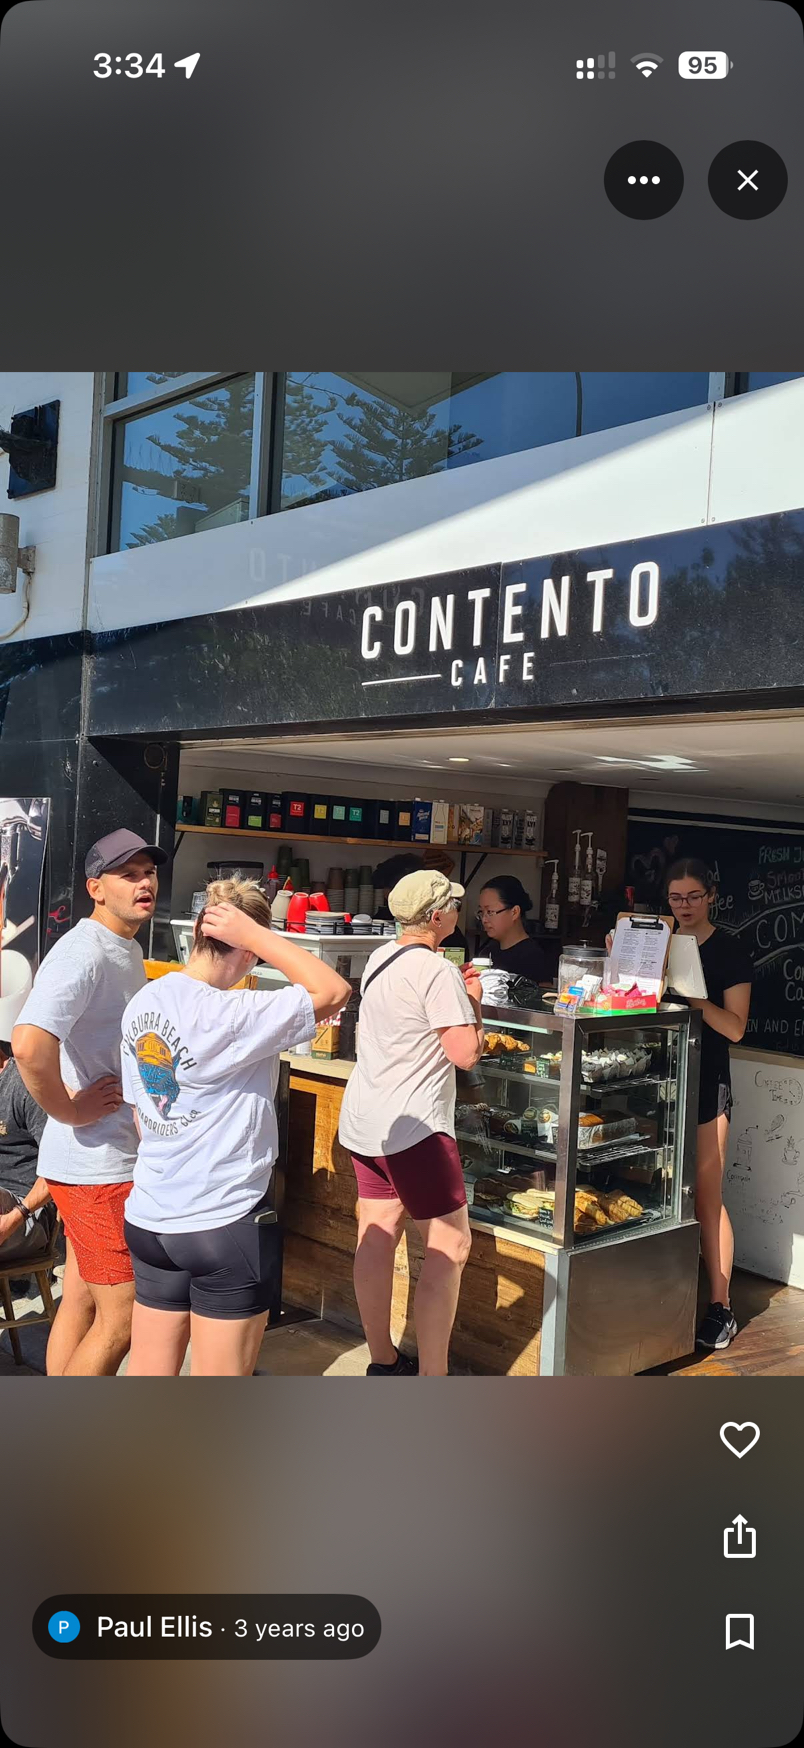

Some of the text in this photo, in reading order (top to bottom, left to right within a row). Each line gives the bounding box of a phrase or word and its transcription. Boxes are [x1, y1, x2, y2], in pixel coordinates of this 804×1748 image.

[360, 560, 660, 661] CONTENTO
[450, 651, 536, 687] CAFE
[293, 803, 302, 811] T2
[758, 845, 790, 864] FRESH
[764, 884, 804, 905] MILKS
[764, 1018, 789, 1034] AND
[161, 1019, 198, 1071] BEACH
